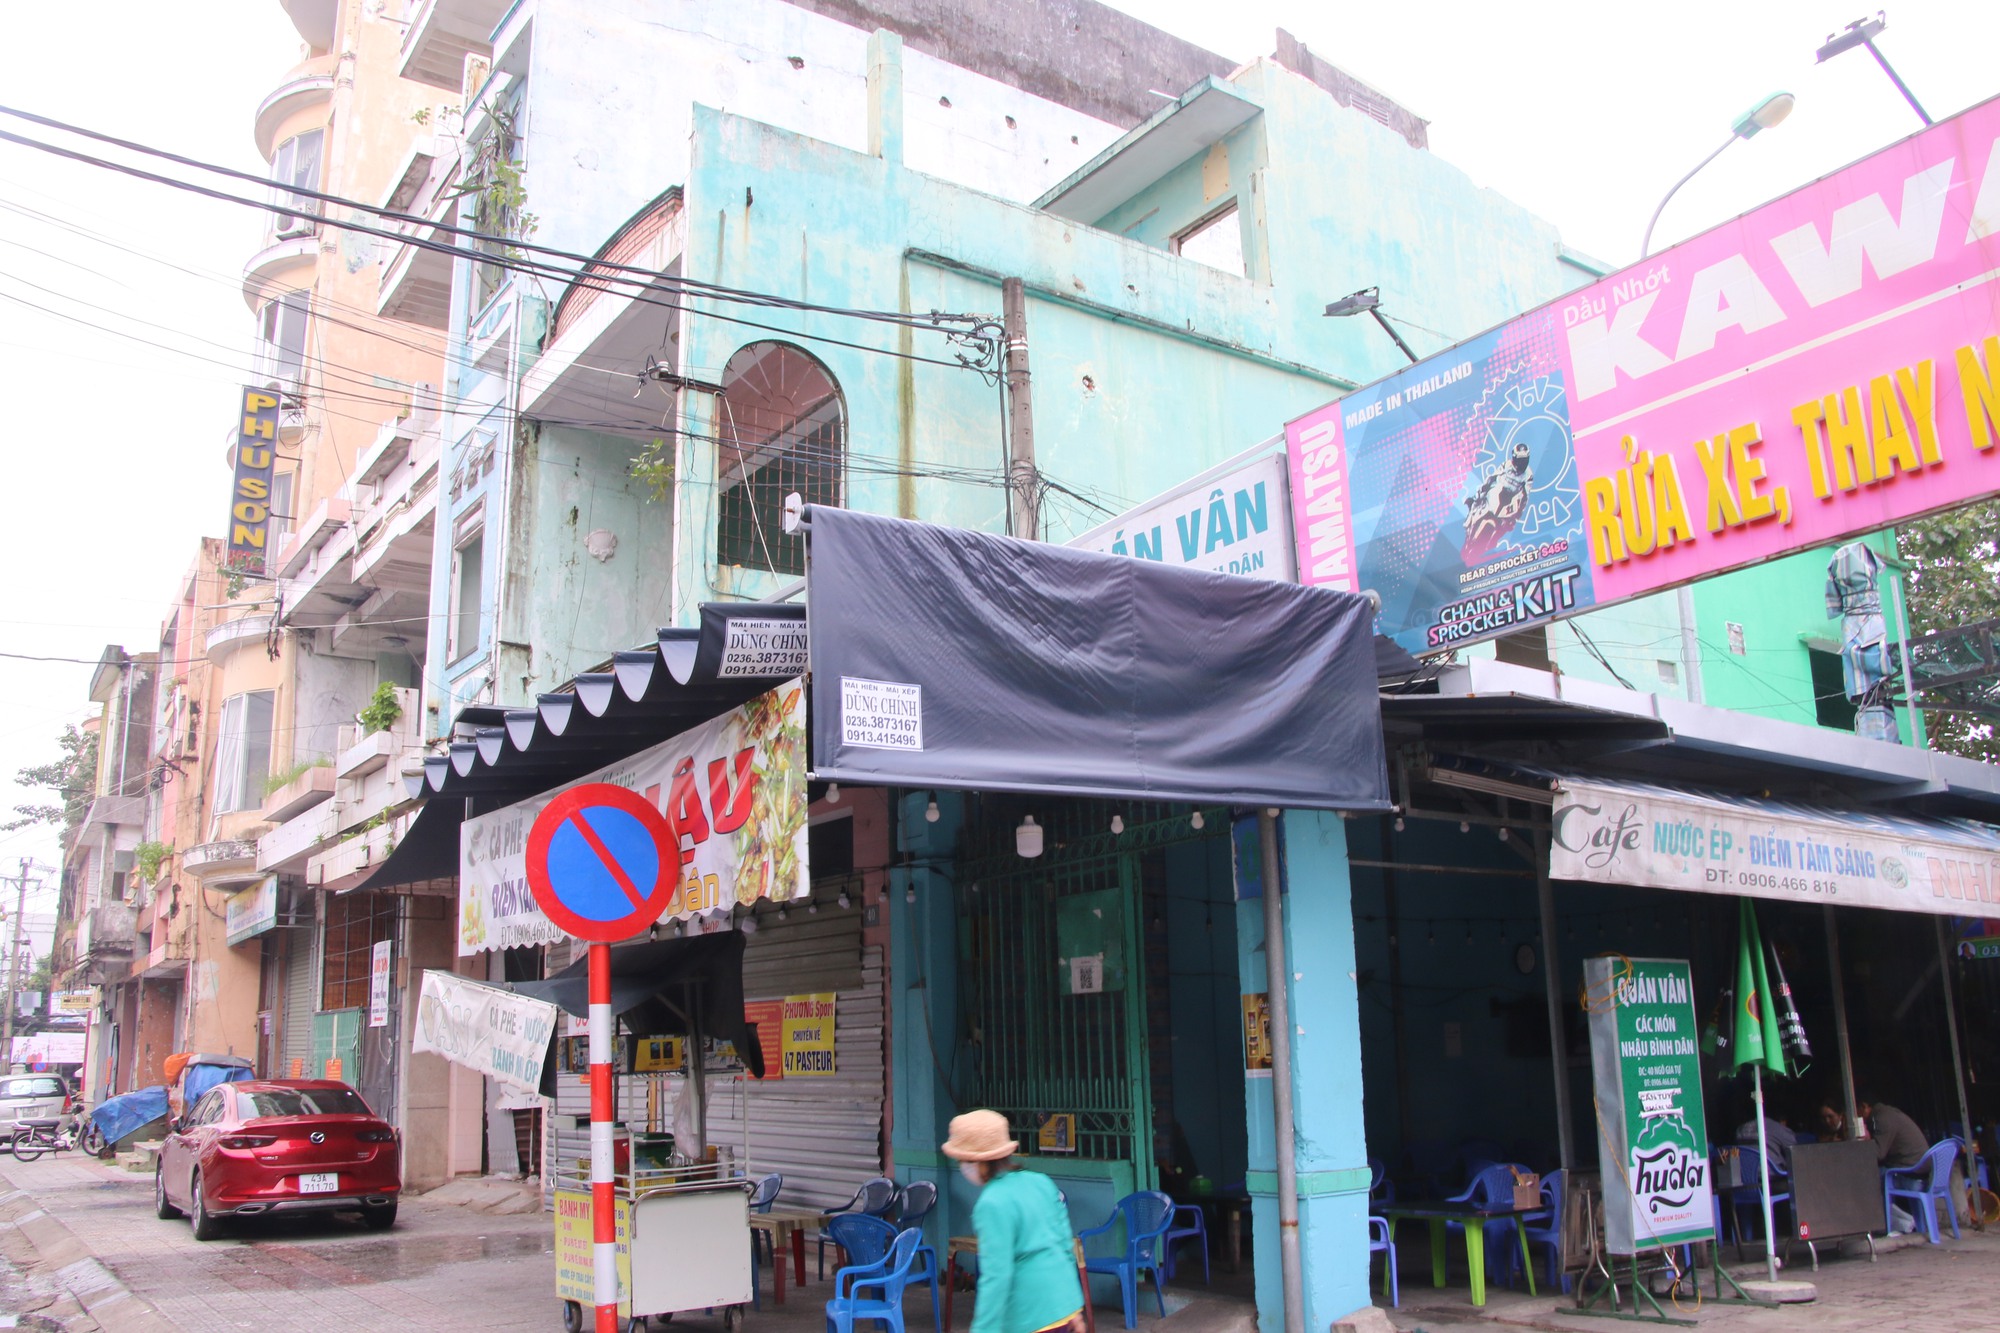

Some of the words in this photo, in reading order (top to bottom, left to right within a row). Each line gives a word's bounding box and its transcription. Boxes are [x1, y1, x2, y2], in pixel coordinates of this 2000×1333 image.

[1563, 297, 1607, 328] Dầu
[1613, 263, 1671, 306] Nhớt
[1345, 401, 1383, 430] MADE
[1386, 392, 1402, 411] IN
[1404, 361, 1473, 402] THAILAND
[1585, 434, 1695, 567] RỬA
[1693, 421, 1792, 534] XE,
[1790, 357, 1943, 500] THAY
[1175, 480, 1269, 563] VÂN
[1459, 567, 1486, 583] REAR
[1487, 550, 1540, 575] SPROCKET
[1541, 540, 1569, 557] S45C
[1513, 566, 1580, 622] KIT
[1440, 594, 1495, 625] CHAIN
[1499, 590, 1514, 608] &
[730, 620, 747, 630] MÁI
[750, 621, 771, 631] HIÊN
[779, 621, 795, 630] MÁI
[1429, 605, 1515, 646] SPROCKET
[730, 629, 768, 650] DŨNG
[724, 665, 804, 675] 0913.415496
[844, 681, 859, 690] MÁI
[861, 683, 878, 692] HIÊN
[885, 685, 899, 695] MÁI
[845, 690, 878, 713] DŨNG
[880, 694, 918, 717] CHÍNH
[845, 714, 918, 732] 0236.3873167
[846, 729, 916, 746] 0913.415496
[1653, 818, 1705, 859] NƯỚC
[1709, 822, 1733, 861] ÉP
[1749, 827, 1792, 869] ĐIỂM
[1796, 836, 1833, 873] TÂM
[1835, 842, 1876, 879] SÁNG
[1705, 868, 1734, 884] ĐT:
[1738, 871, 1808, 891] 0906.466
[1813, 880, 1837, 894] 816
[1617, 971, 1657, 1008] QUÁN
[1658, 972, 1688, 1004] VÂN
[1635, 1013, 1653, 1033] CÁC
[1654, 1013, 1676, 1033] MÓN
[784, 1051, 794, 1071] 47
[796, 1050, 833, 1072] PASTEUR
[1620, 1038, 1649, 1061] NHẬU
[1650, 1036, 1673, 1056] BÌNH
[1674, 1036, 1695, 1055] DÂN
[310, 1173, 327, 1183] 43A
[1635, 1147, 1704, 1196] huda
[304, 1182, 335, 1192] 711.70
[559, 1196, 578, 1218] BÁNH
[1653, 1214, 1674, 1223] PREMIUM
[1674, 1212, 1693, 1221] QUALITY
